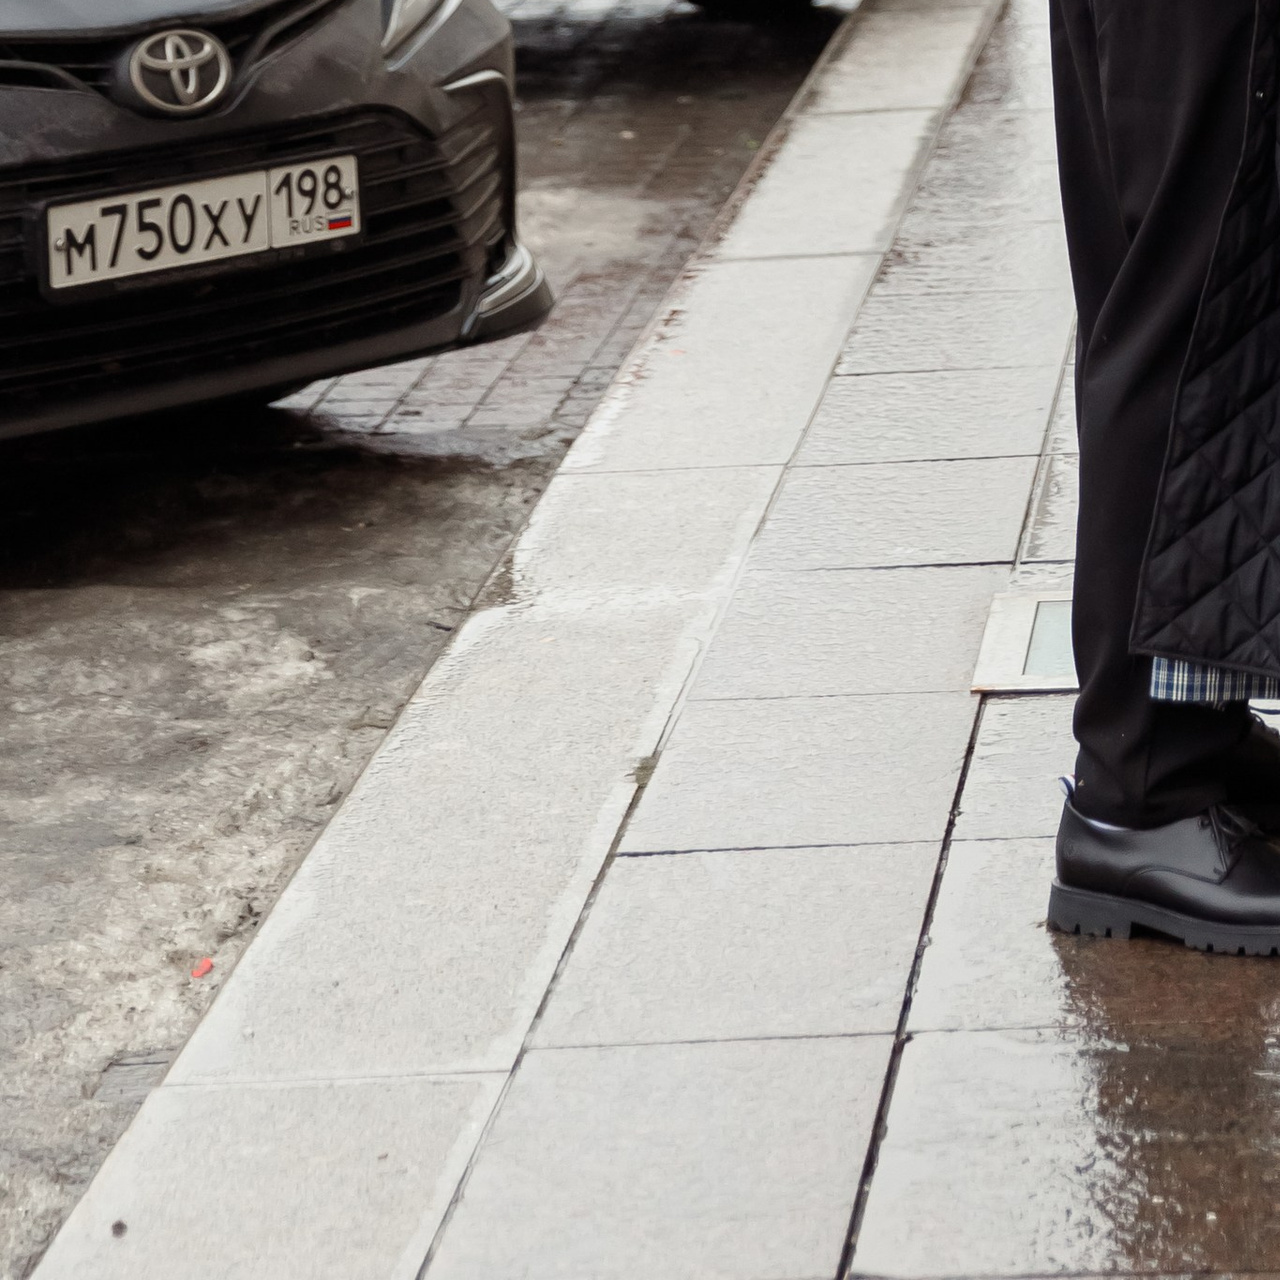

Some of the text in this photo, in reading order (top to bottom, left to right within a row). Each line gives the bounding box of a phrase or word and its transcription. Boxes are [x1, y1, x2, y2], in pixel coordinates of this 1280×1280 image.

[64, 164, 343, 276] М750ХУ 198
[288, 215, 326, 236] RUS
